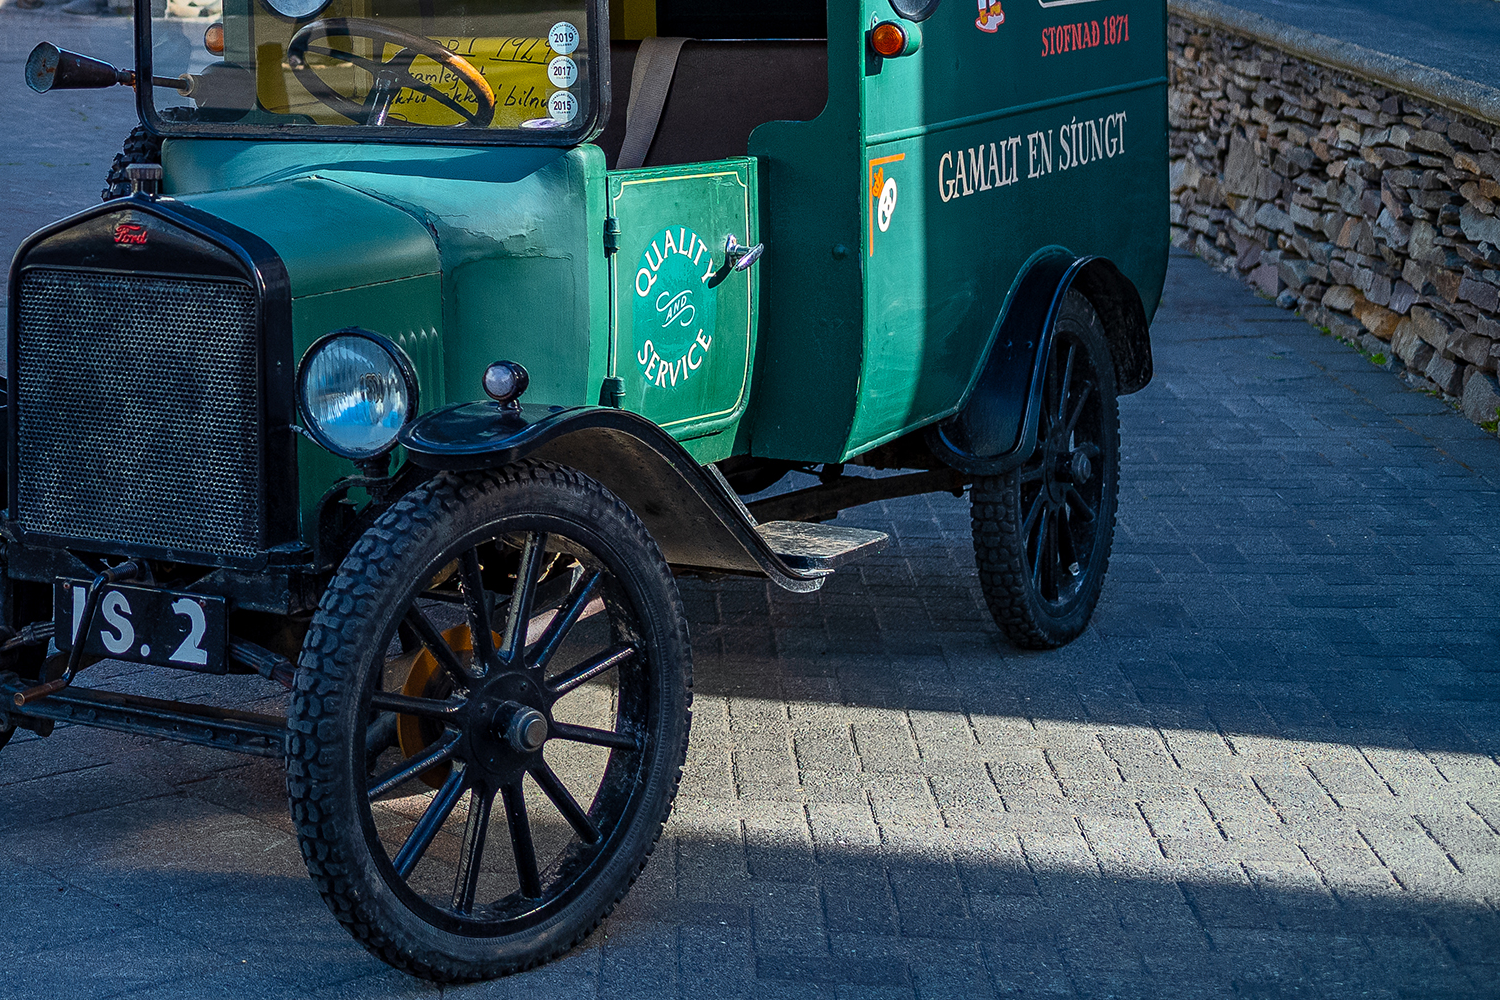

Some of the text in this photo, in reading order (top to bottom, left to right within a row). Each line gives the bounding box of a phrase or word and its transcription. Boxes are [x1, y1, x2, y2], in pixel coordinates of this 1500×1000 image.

[554, 32, 574, 43] 2019
[1041, 14, 1130, 58] STOFNAÐ 1871
[553, 66, 572, 76] 2017
[553, 101, 572, 111] 2015
[939, 111, 1127, 203] GAMALT EN SÍUNGT
[114, 224, 148, 244] Ford
[635, 227, 717, 298] QUALITY
[665, 295, 688, 322] AND
[637, 328, 712, 389] SERVICE
[168, 598, 208, 665] 2
